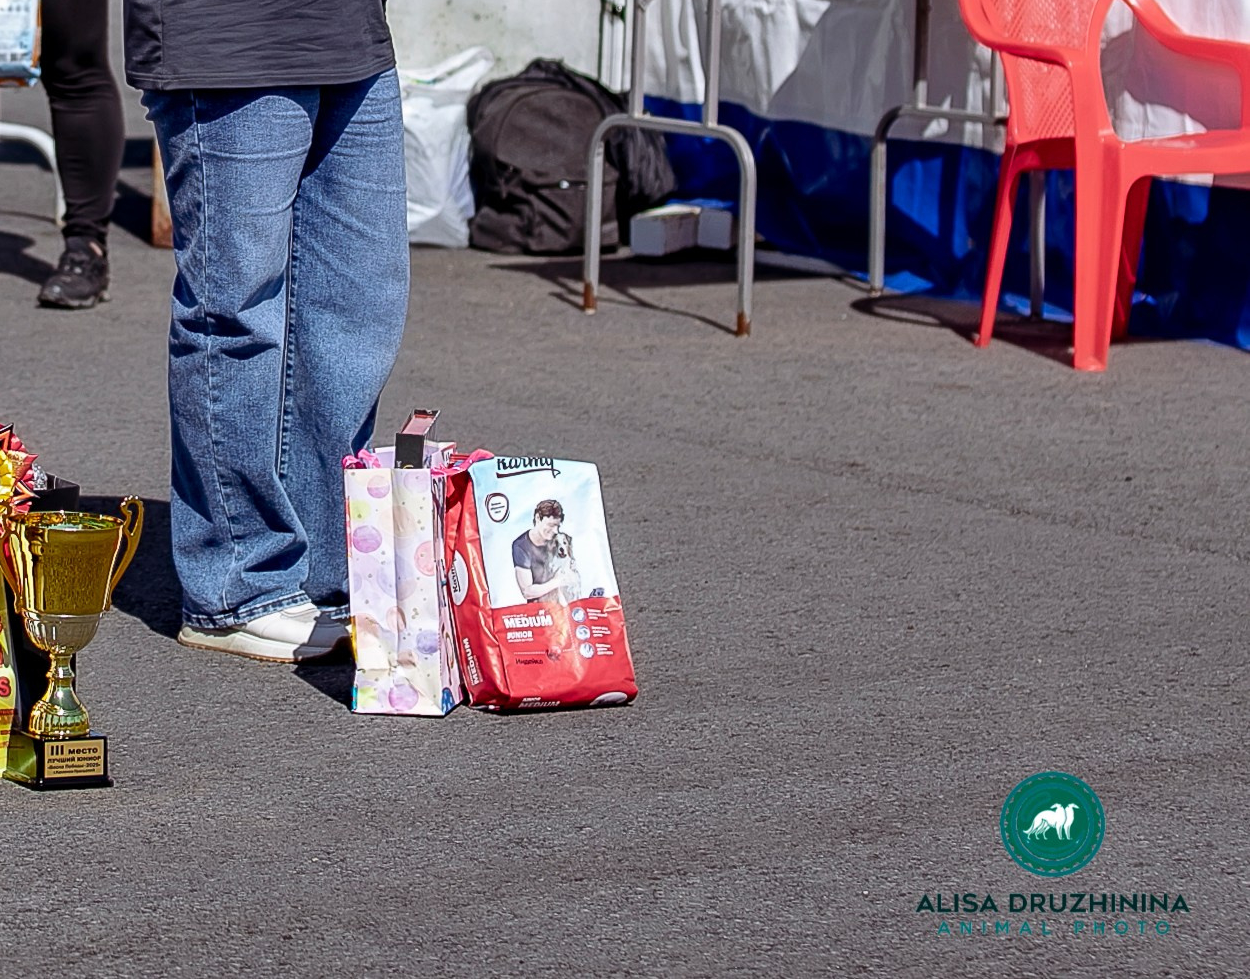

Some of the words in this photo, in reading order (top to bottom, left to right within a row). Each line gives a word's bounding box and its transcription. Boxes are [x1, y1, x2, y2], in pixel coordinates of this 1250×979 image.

[503, 614, 553, 629] MEDIUM
[506, 630, 533, 639] JUNIOR
[463, 638, 479, 685] MEDIUM
[68, 747, 98, 755] место
[77, 755, 101, 763] ЮНИОР
